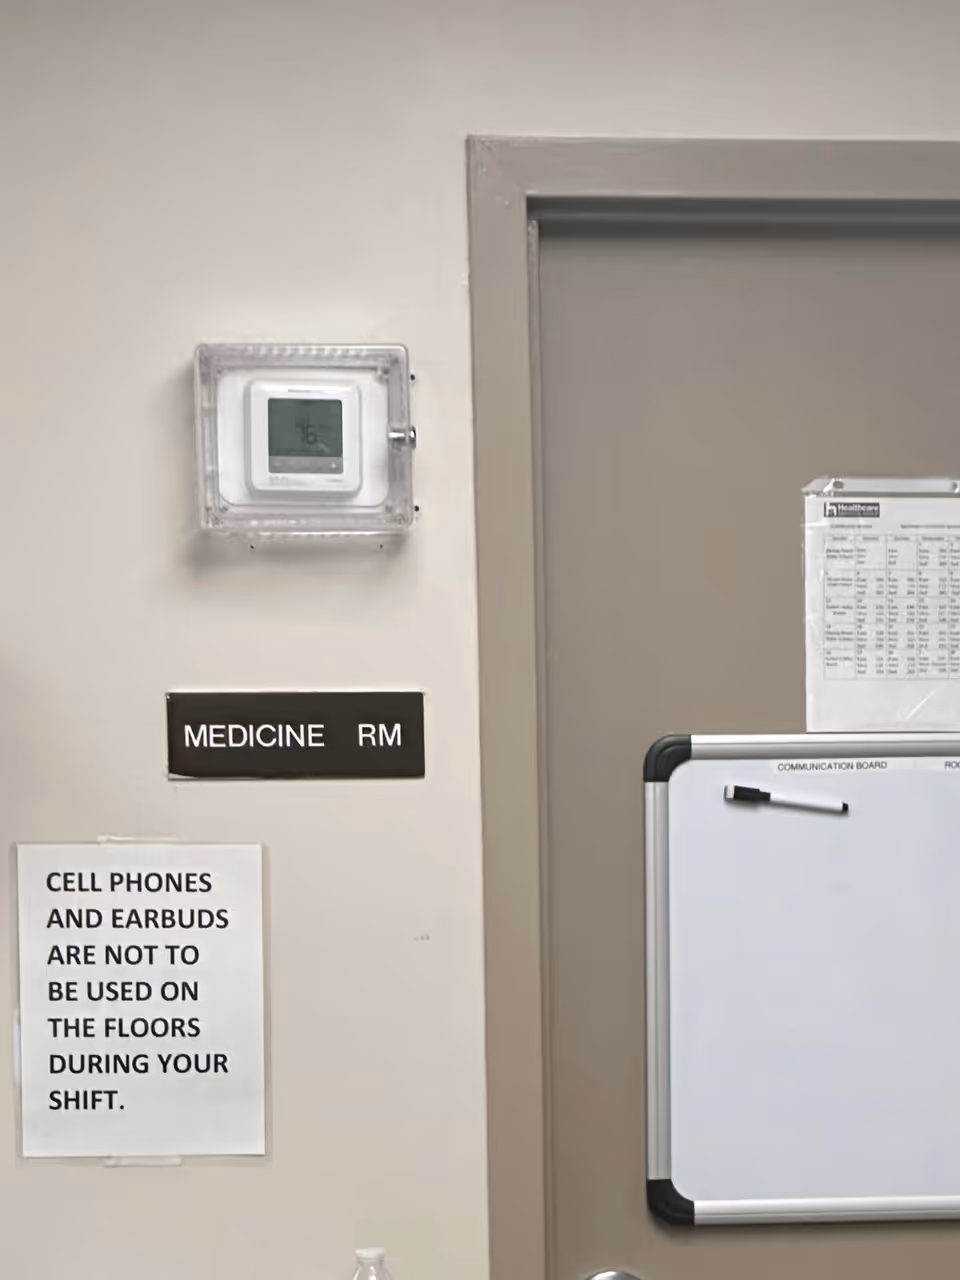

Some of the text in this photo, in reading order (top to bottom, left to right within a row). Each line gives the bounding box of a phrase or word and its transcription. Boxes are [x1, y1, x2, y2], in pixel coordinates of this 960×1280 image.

[184, 723, 401, 747] MEDICINE RM
[777, 761, 887, 771] COMMUNICATION BOARD
[46, 872, 212, 893] CELL PHONES
[47, 908, 229, 929] AND EARBUDS
[47, 945, 200, 965] ARE NOT TO
[49, 981, 199, 1001] BE USED ON
[48, 1017, 201, 1038] THE FLOORS
[49, 1054, 228, 1074] DURING YOUR
[49, 1090, 124, 1110] SHIFT.
